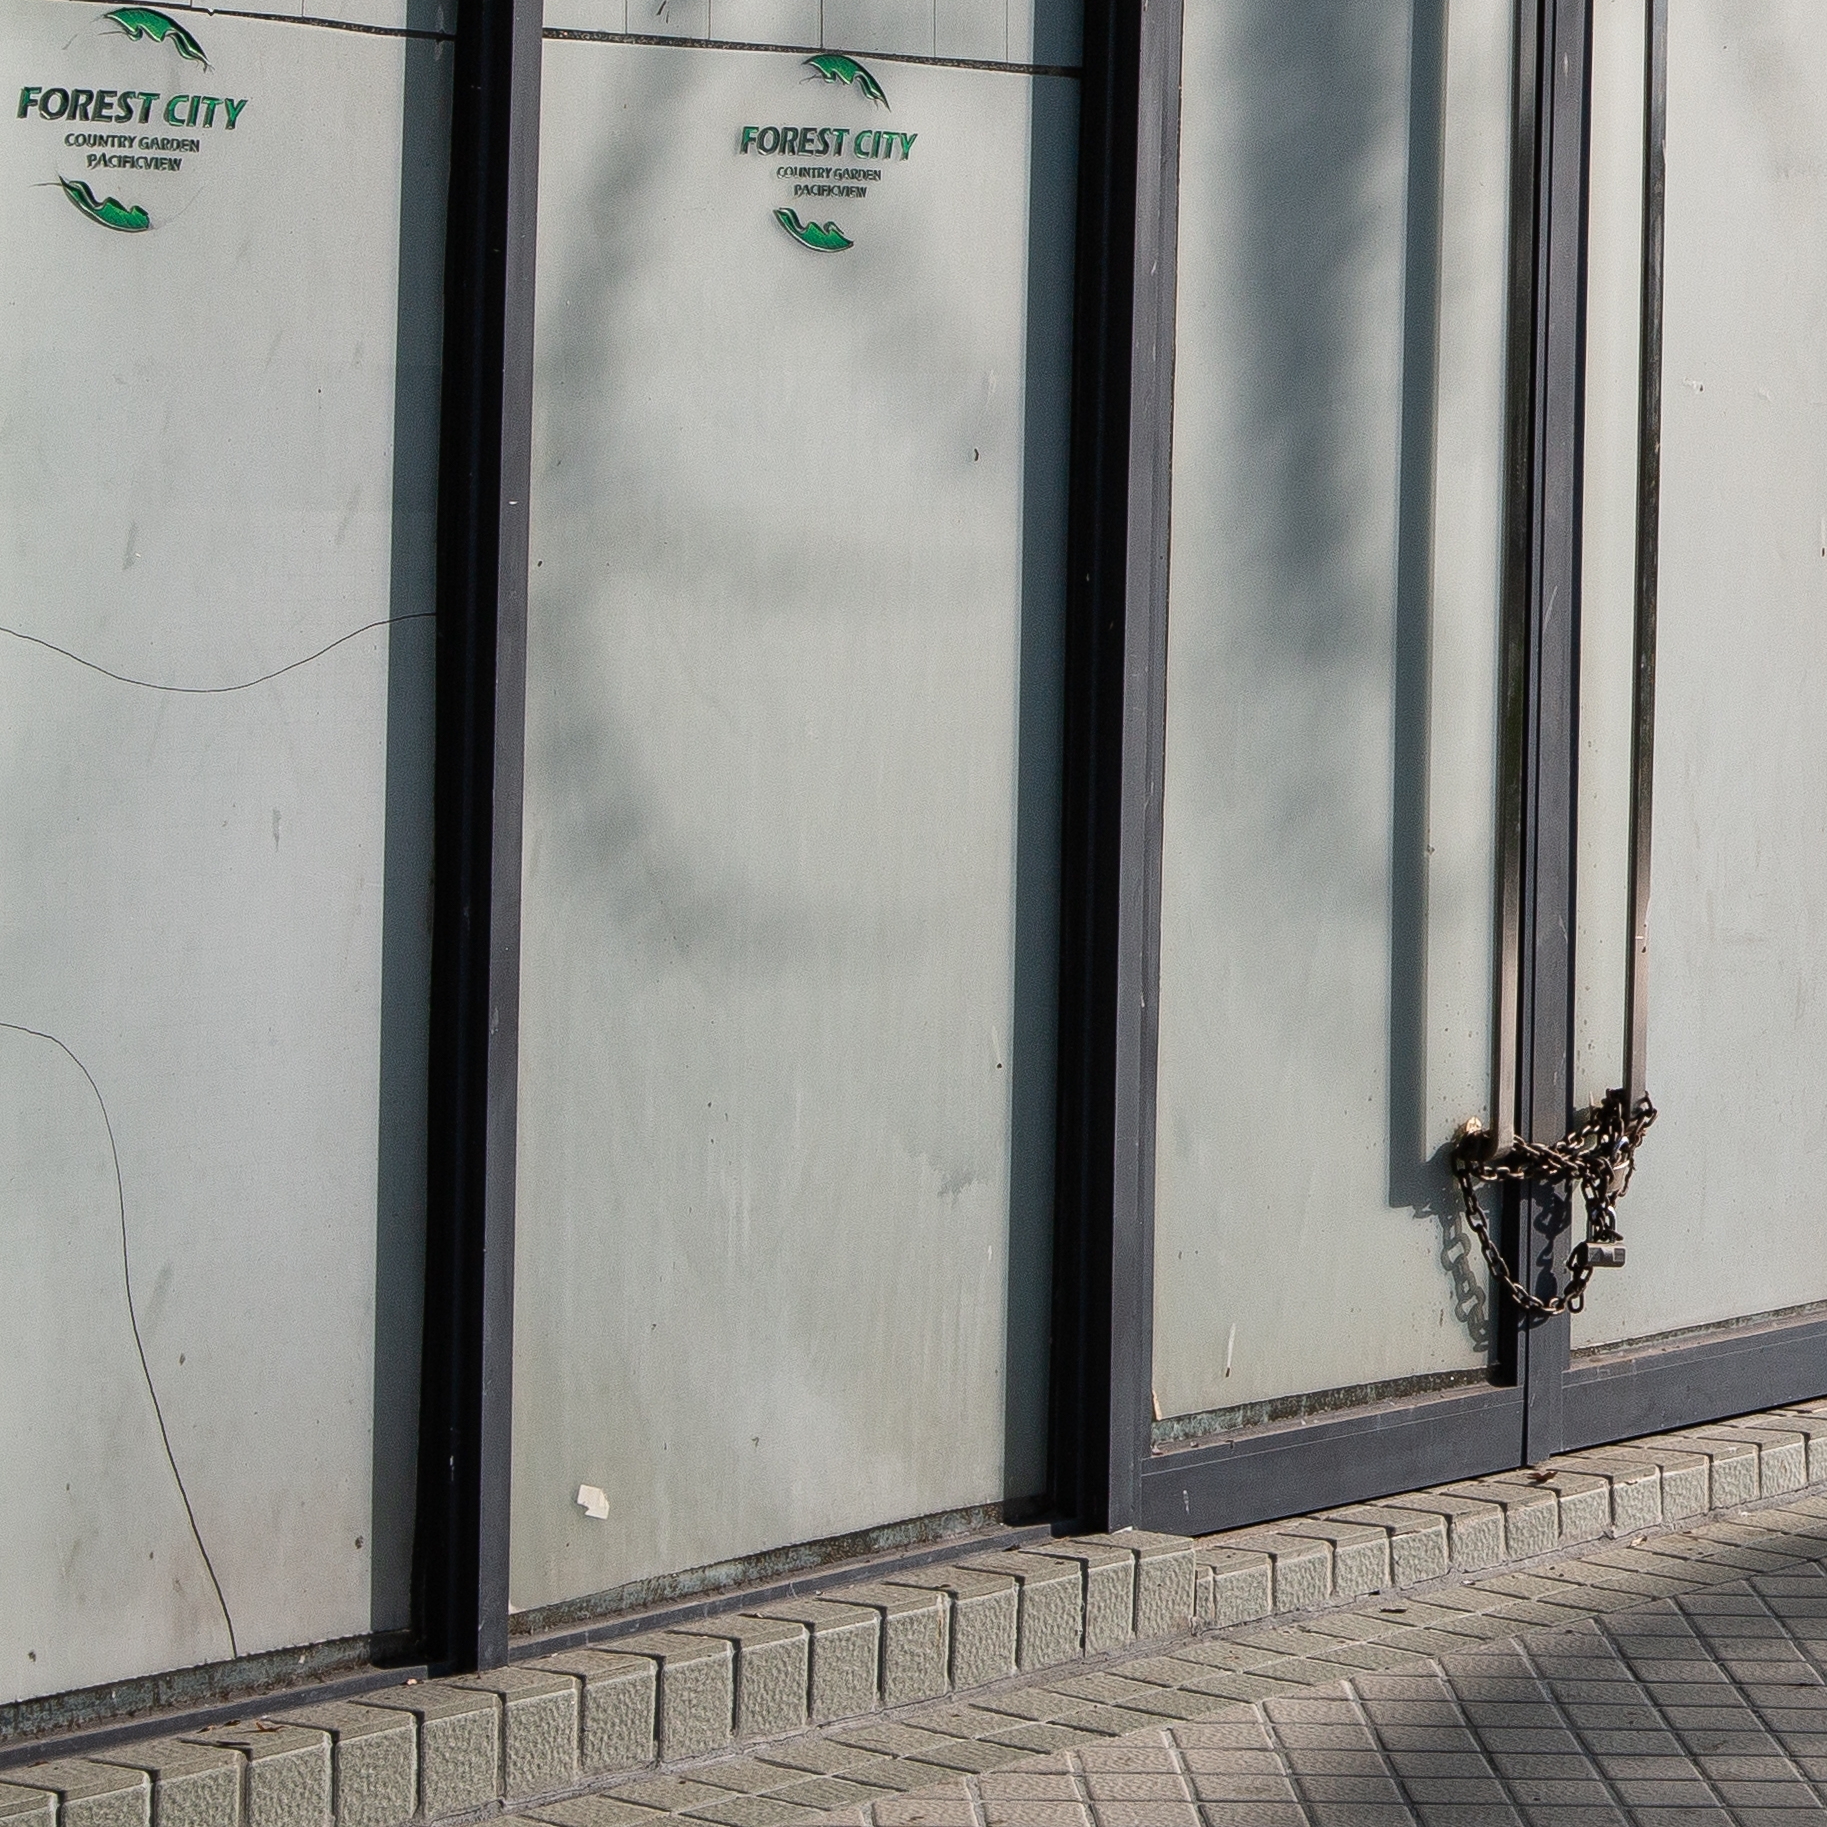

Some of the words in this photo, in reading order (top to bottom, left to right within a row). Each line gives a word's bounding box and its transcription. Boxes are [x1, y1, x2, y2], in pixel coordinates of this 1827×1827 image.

[16, 86, 160, 124] FOREST
[163, 94, 248, 130] CITY
[64, 133, 137, 149] COUNTRY
[138, 136, 200, 153] GARDEN
[739, 126, 850, 157] FOREST
[854, 129, 918, 161] CITY
[777, 166, 833, 180] COUNTRY
